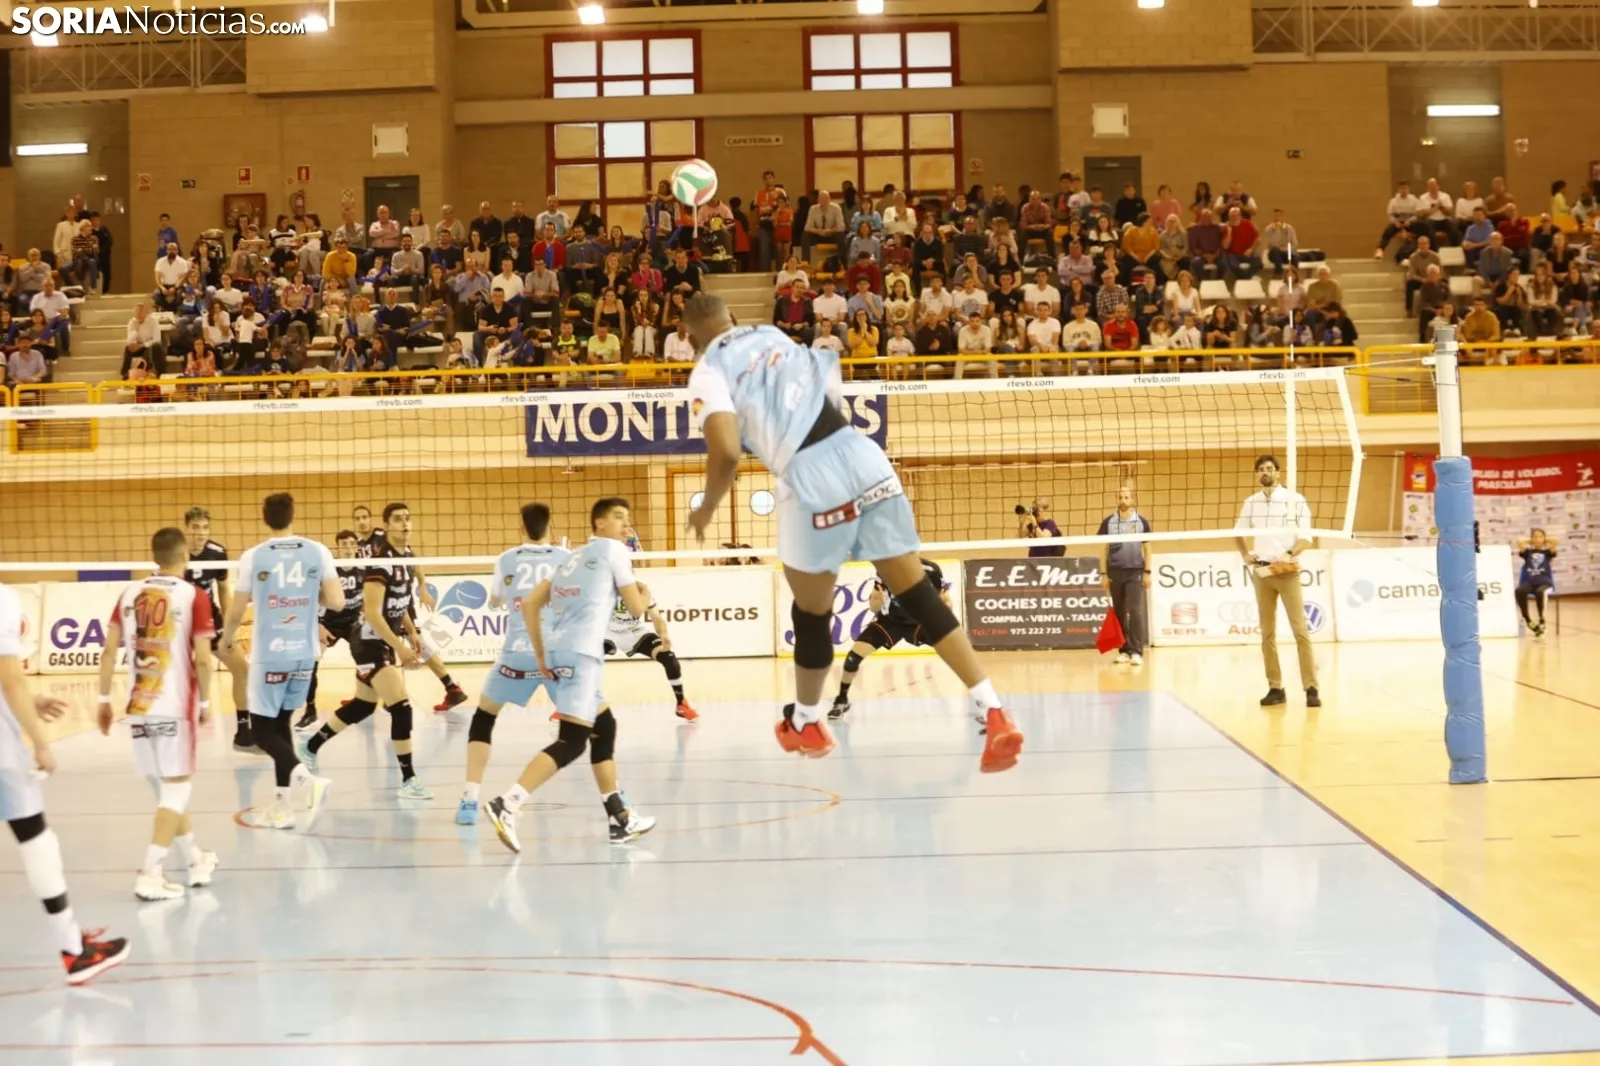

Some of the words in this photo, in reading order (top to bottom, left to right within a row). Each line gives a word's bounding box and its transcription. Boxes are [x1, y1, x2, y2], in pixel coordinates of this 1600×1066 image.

[1006, 378, 1054, 388] rfevb.com
[1133, 375, 1181, 384] rfevb.com
[880, 382, 928, 392] rfevb.com
[501, 393, 549, 403] rfevb.com
[627, 390, 675, 400] rfevb.com
[253, 401, 299, 410] rfevb.com
[376, 397, 423, 407] rfevb.com
[130, 404, 177, 413] rfevb.com
[272, 560, 306, 589] 14
[1158, 565, 1232, 588] Soria
[974, 598, 1038, 611] COCHES
[1041, 597, 1063, 610] DE
[134, 596, 168, 631] 10
[981, 615, 1024, 624] COMPRA
[1030, 614, 1065, 623] VENTA
[1028, 627, 1044, 635] 222
